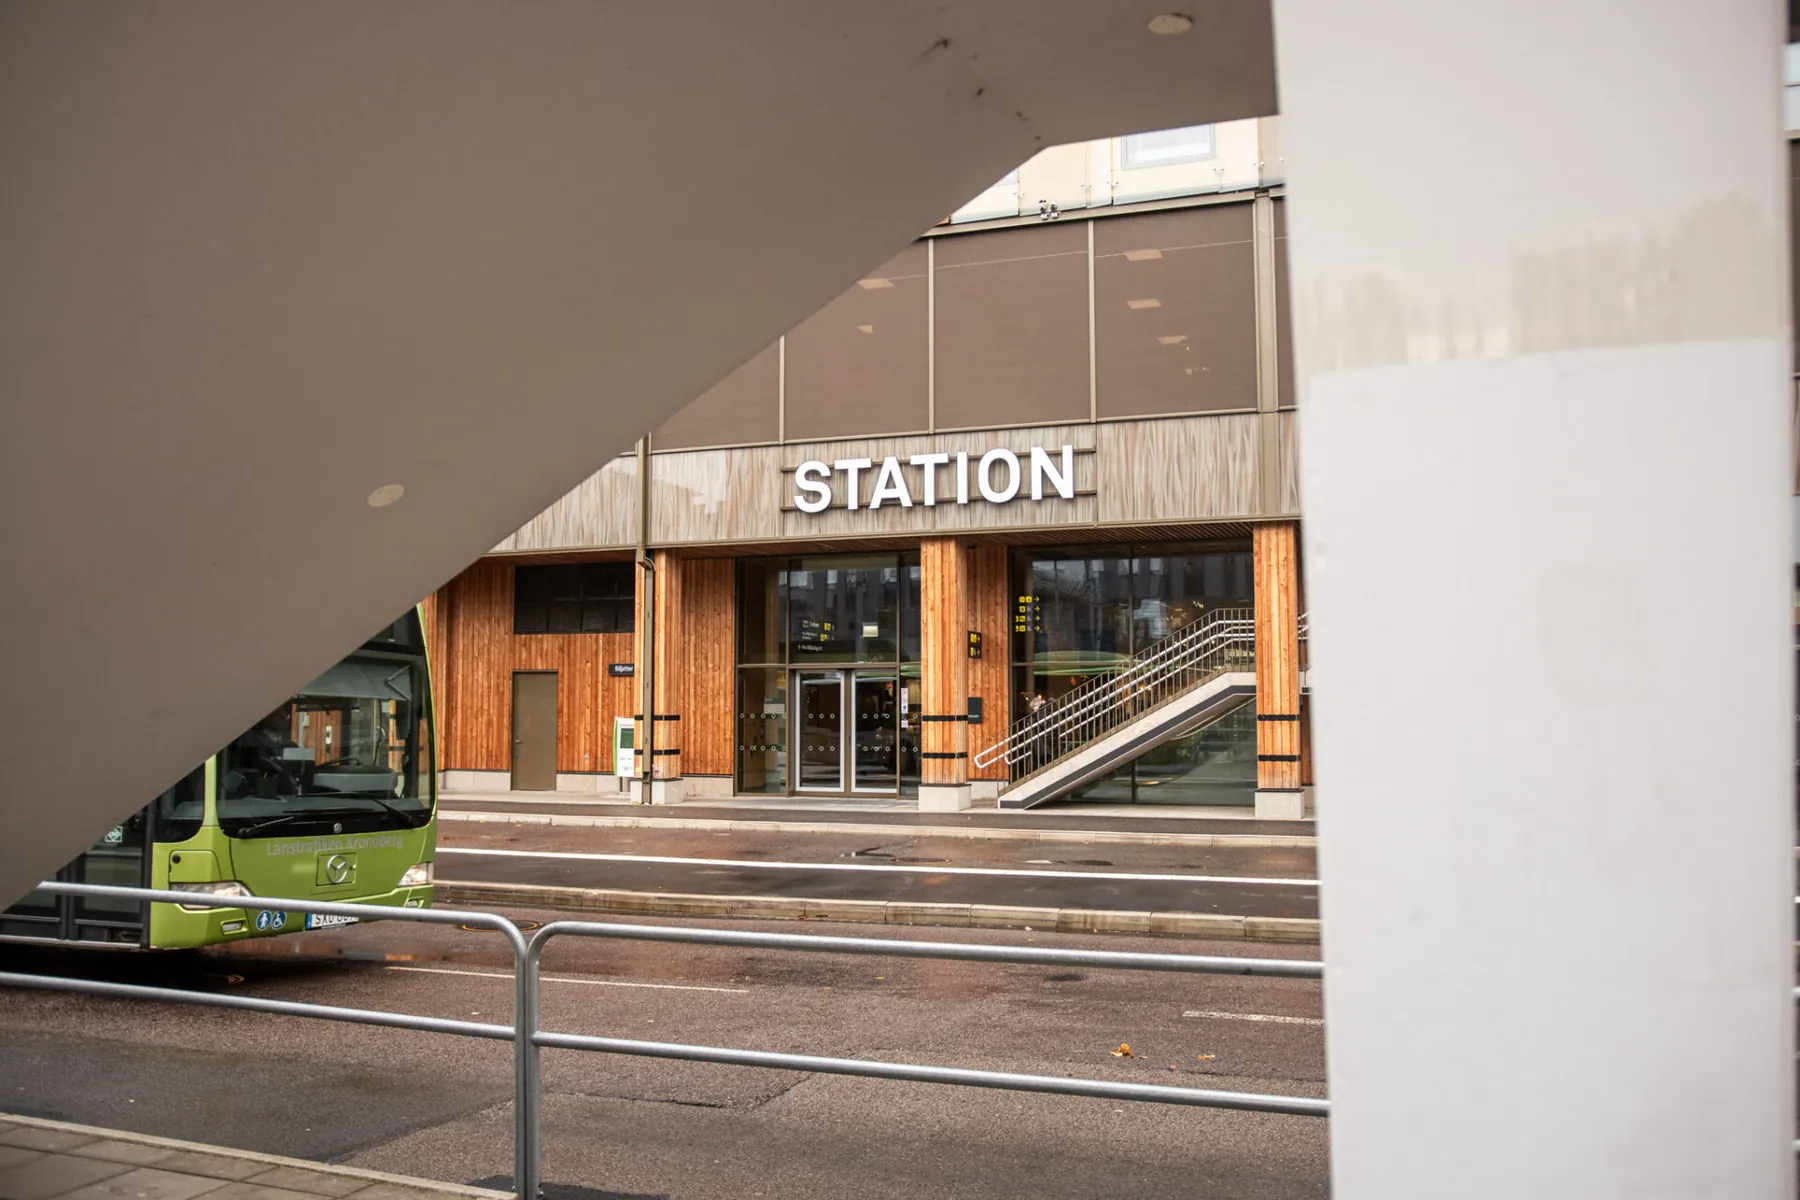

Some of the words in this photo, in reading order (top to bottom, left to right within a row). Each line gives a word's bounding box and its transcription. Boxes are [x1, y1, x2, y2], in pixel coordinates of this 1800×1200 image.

[793, 444, 1075, 514] STATION
[267, 837, 342, 856] Länstrafiken
[348, 834, 402, 850] Kronoberg
